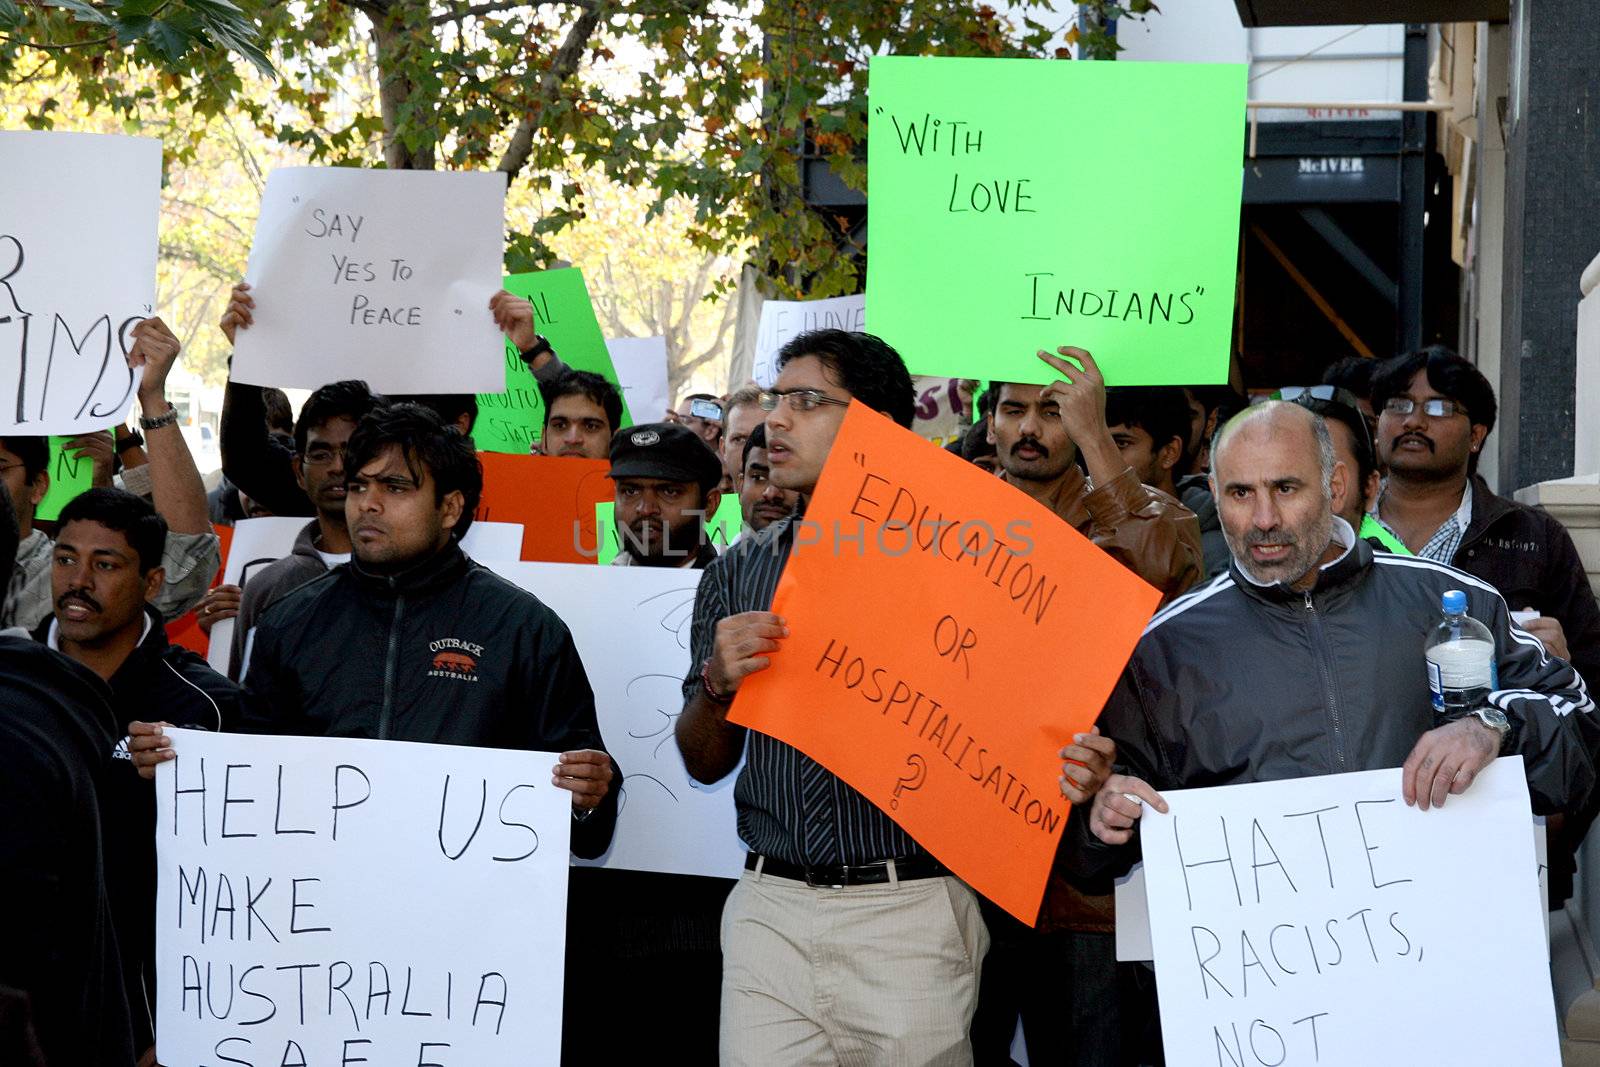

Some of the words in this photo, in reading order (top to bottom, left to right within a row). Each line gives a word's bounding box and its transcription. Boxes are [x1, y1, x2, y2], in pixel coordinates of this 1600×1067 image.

[949, 173, 1037, 214] LOVE
[1298, 157, 1364, 173] McIVER
[331, 254, 376, 285] YES
[427, 670, 480, 682] AUSTRALIA
[934, 615, 977, 680] OR
[174, 754, 371, 846] HELP
[438, 774, 539, 862] US
[1173, 799, 1413, 911] HATE
[177, 865, 332, 944] MAKE
[1191, 909, 1424, 1000] RACISTS,
[182, 955, 507, 1035] AUSTRALIA
[1214, 1012, 1329, 1067] NOT
